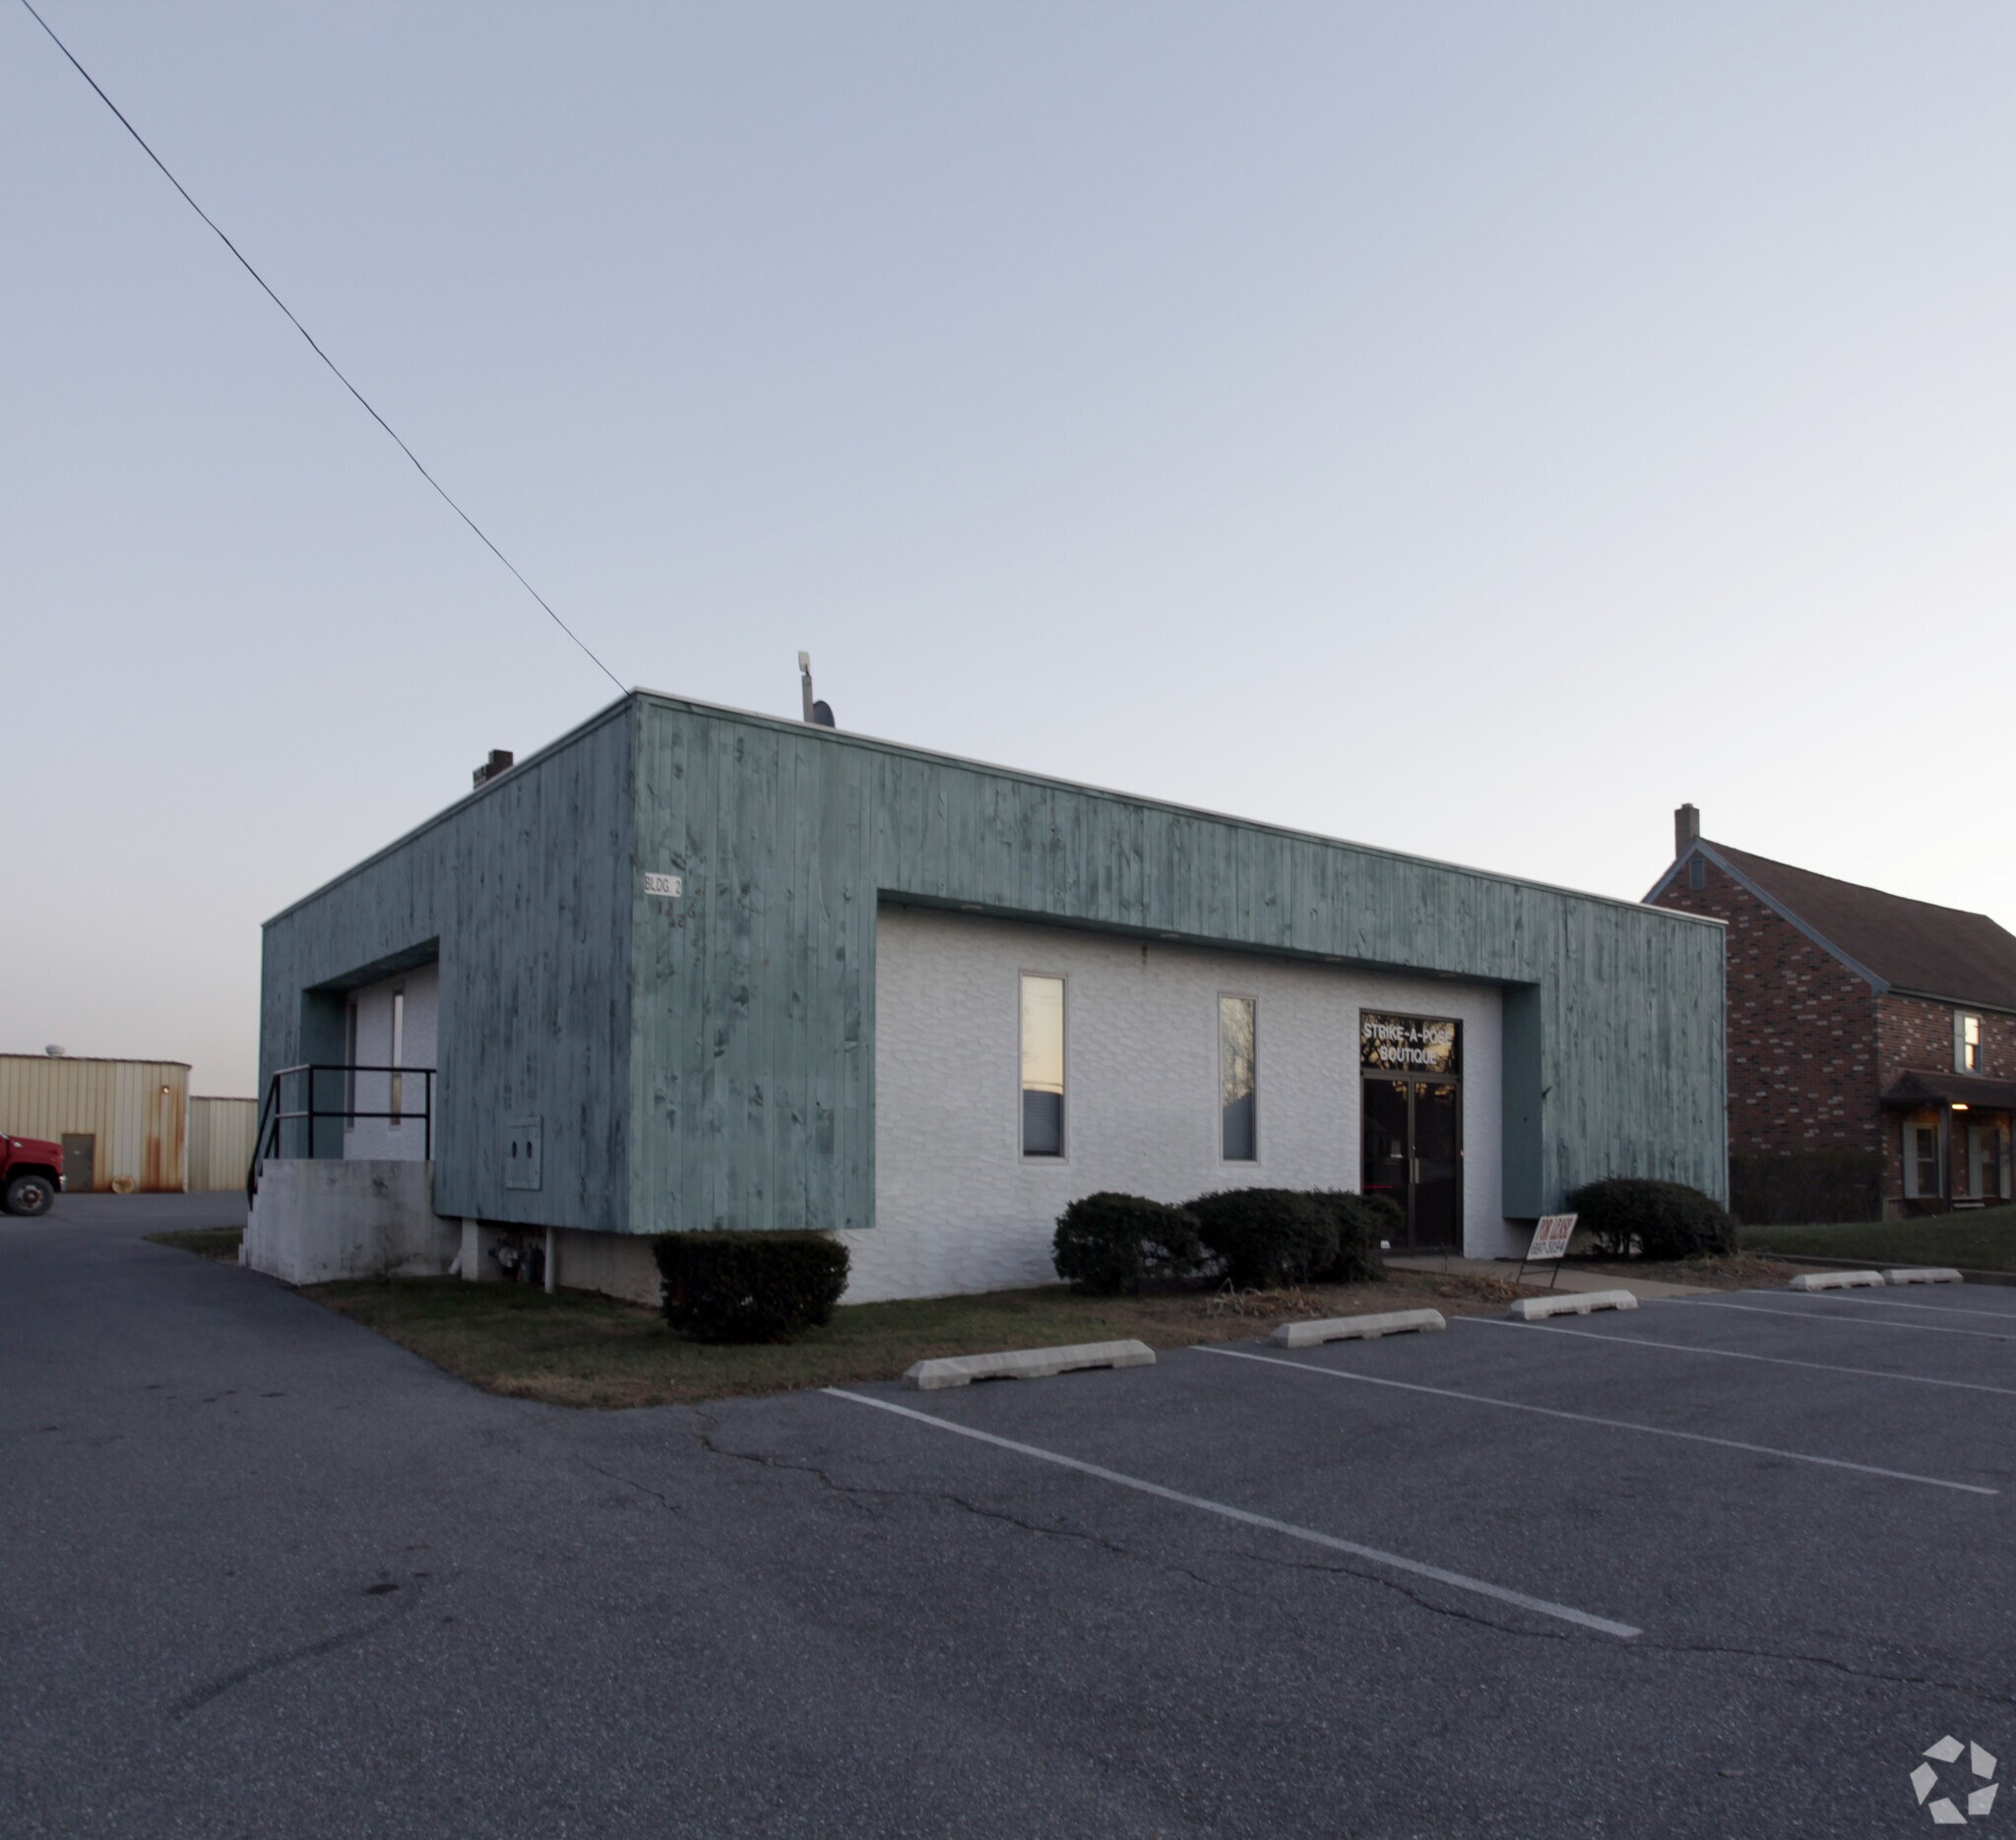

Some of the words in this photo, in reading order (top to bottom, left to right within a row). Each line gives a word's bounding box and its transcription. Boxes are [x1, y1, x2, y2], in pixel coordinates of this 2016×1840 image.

[675, 879, 681, 895] 2
[1363, 1022, 1452, 1045] STRIKE-A-POSE
[1380, 1045, 1437, 1064] BOUTIQUE
